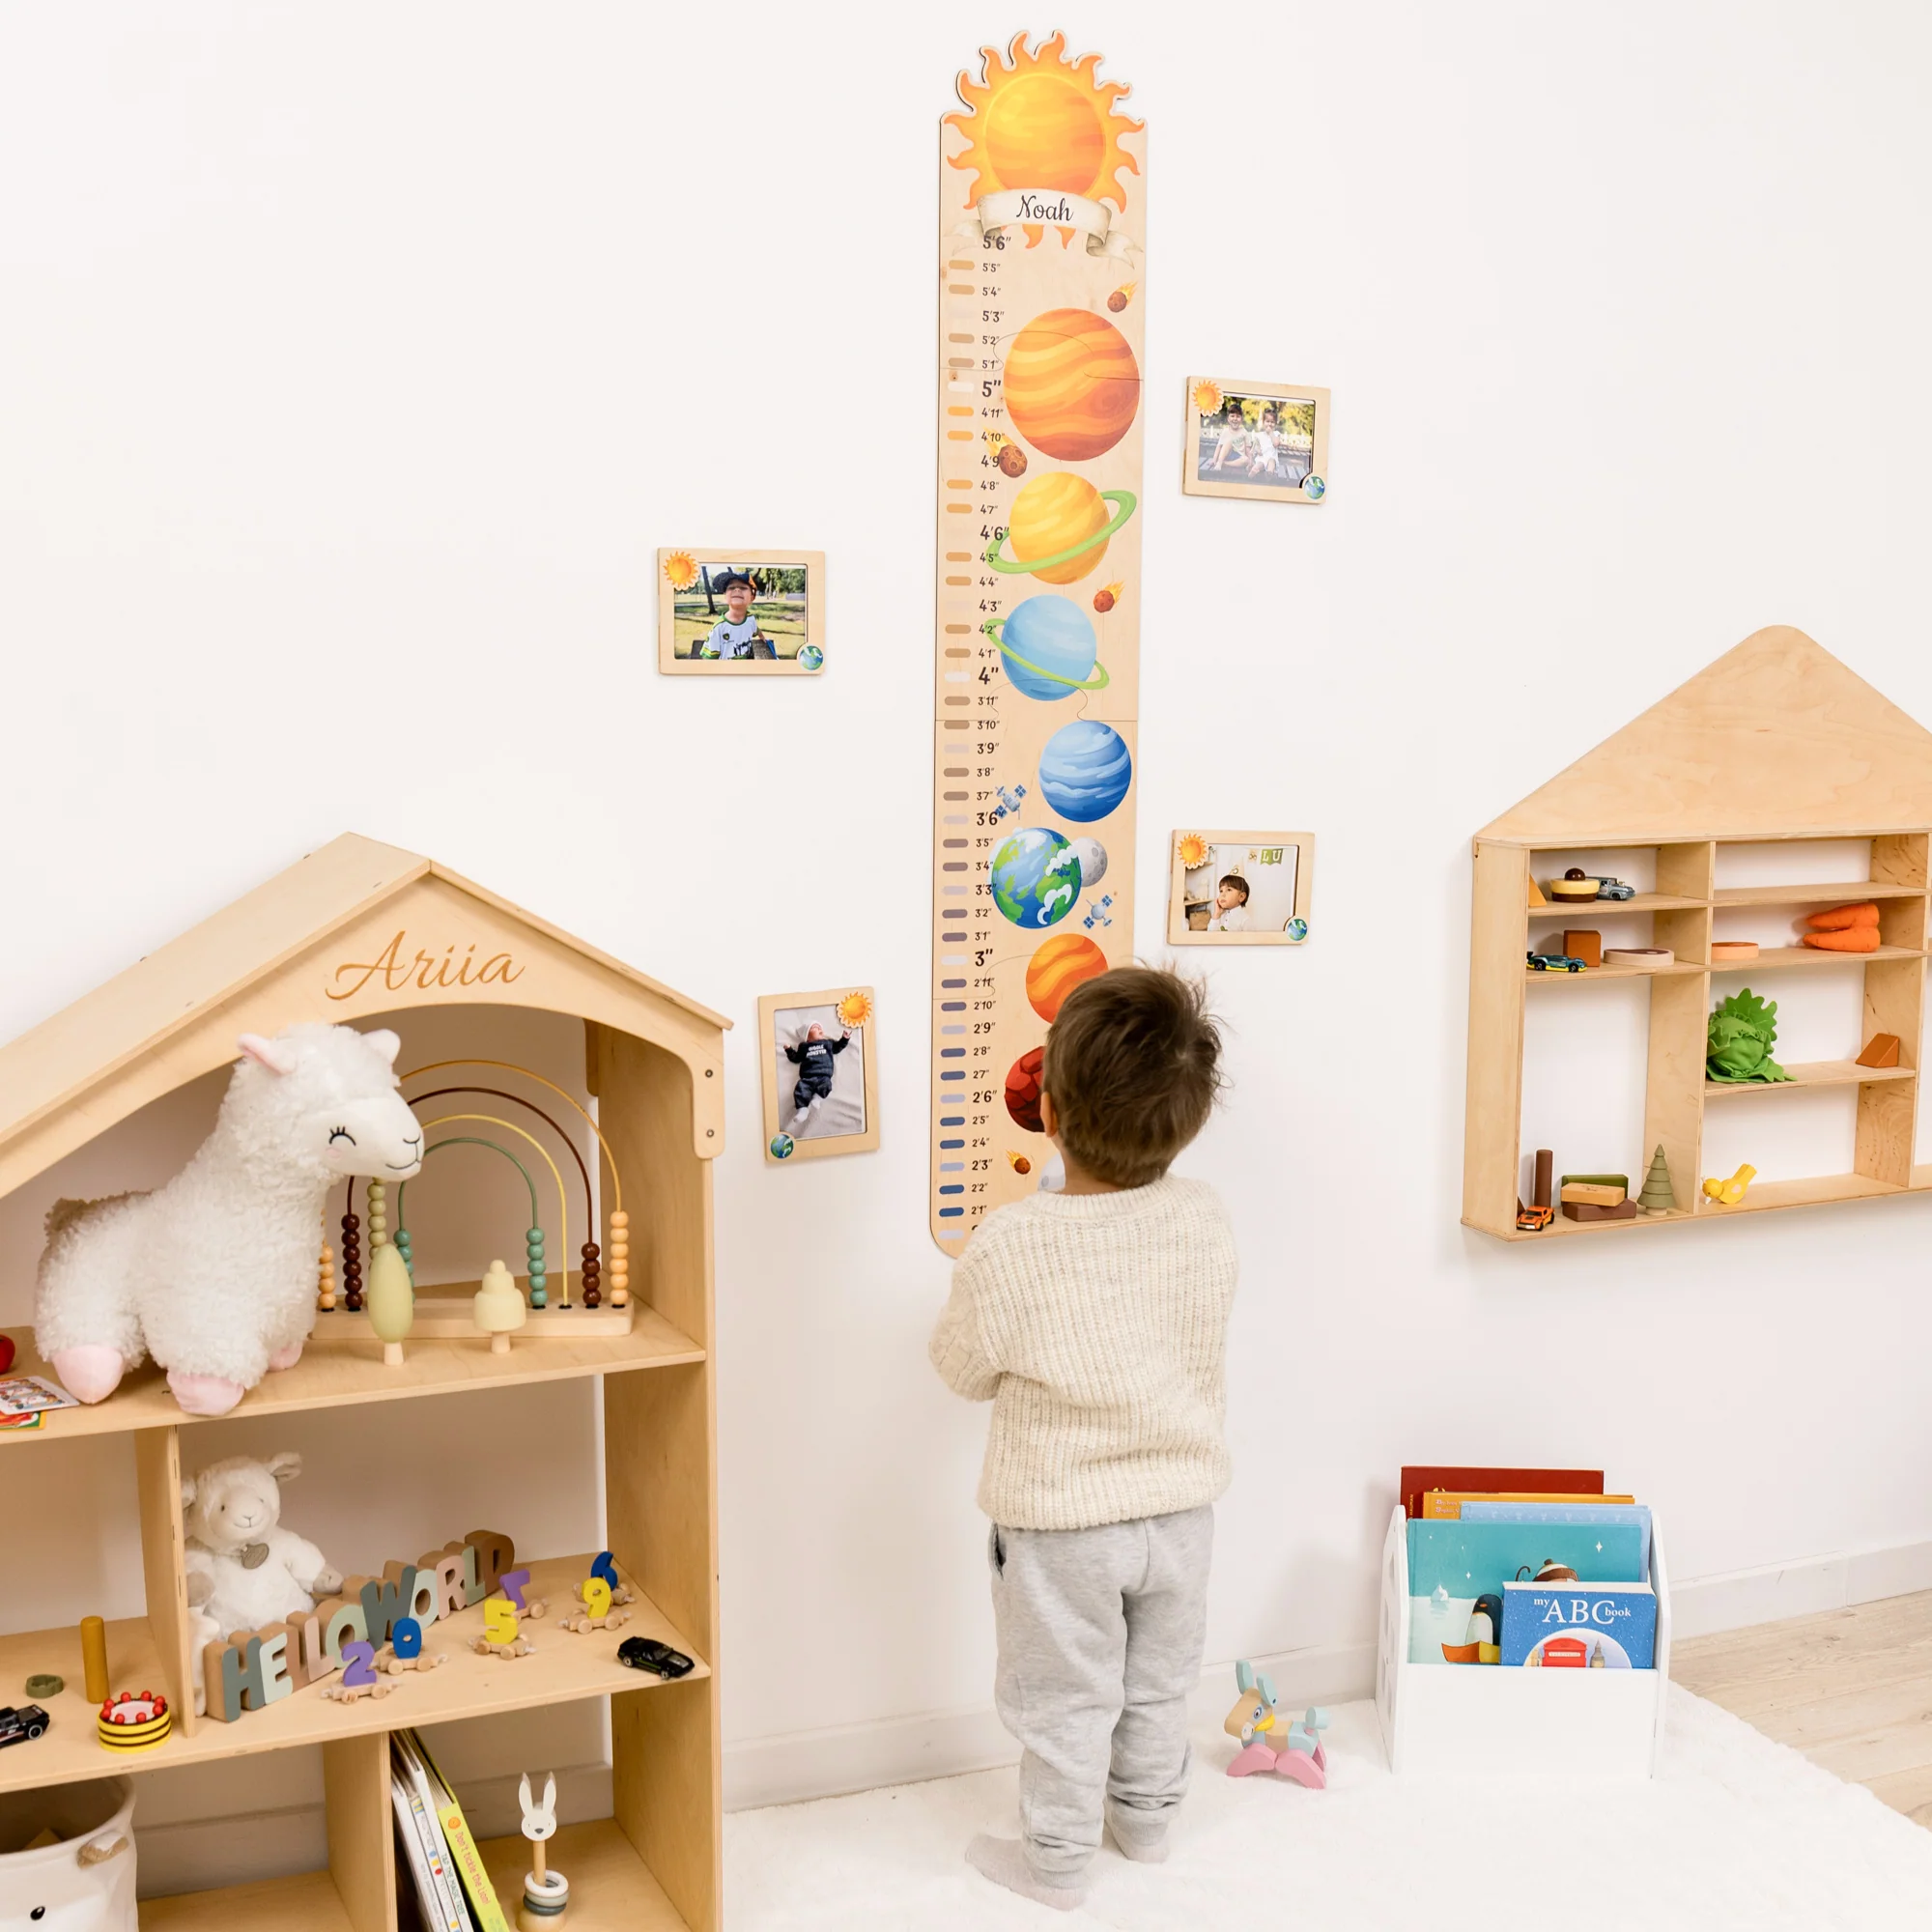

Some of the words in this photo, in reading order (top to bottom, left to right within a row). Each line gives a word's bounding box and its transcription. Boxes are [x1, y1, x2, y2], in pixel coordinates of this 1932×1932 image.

[1016, 195, 1074, 221] Noah
[326, 930, 526, 1001] Ariia
[360, 1530, 515, 1652] WORLD
[582, 1577, 611, 1618] 9
[1534, 1598, 1550, 1608] my
[1542, 1599, 1615, 1625] ABC
[1605, 1606, 1632, 1618] book
[484, 1599, 518, 1644] 5
[222, 1605, 369, 1722] HELLO
[341, 1640, 377, 1687] 2
[445, 1865, 454, 1878] THE
[455, 1898, 466, 1915] TREE
[464, 1852, 476, 1874] tickle
[472, 1873, 482, 1888] the
